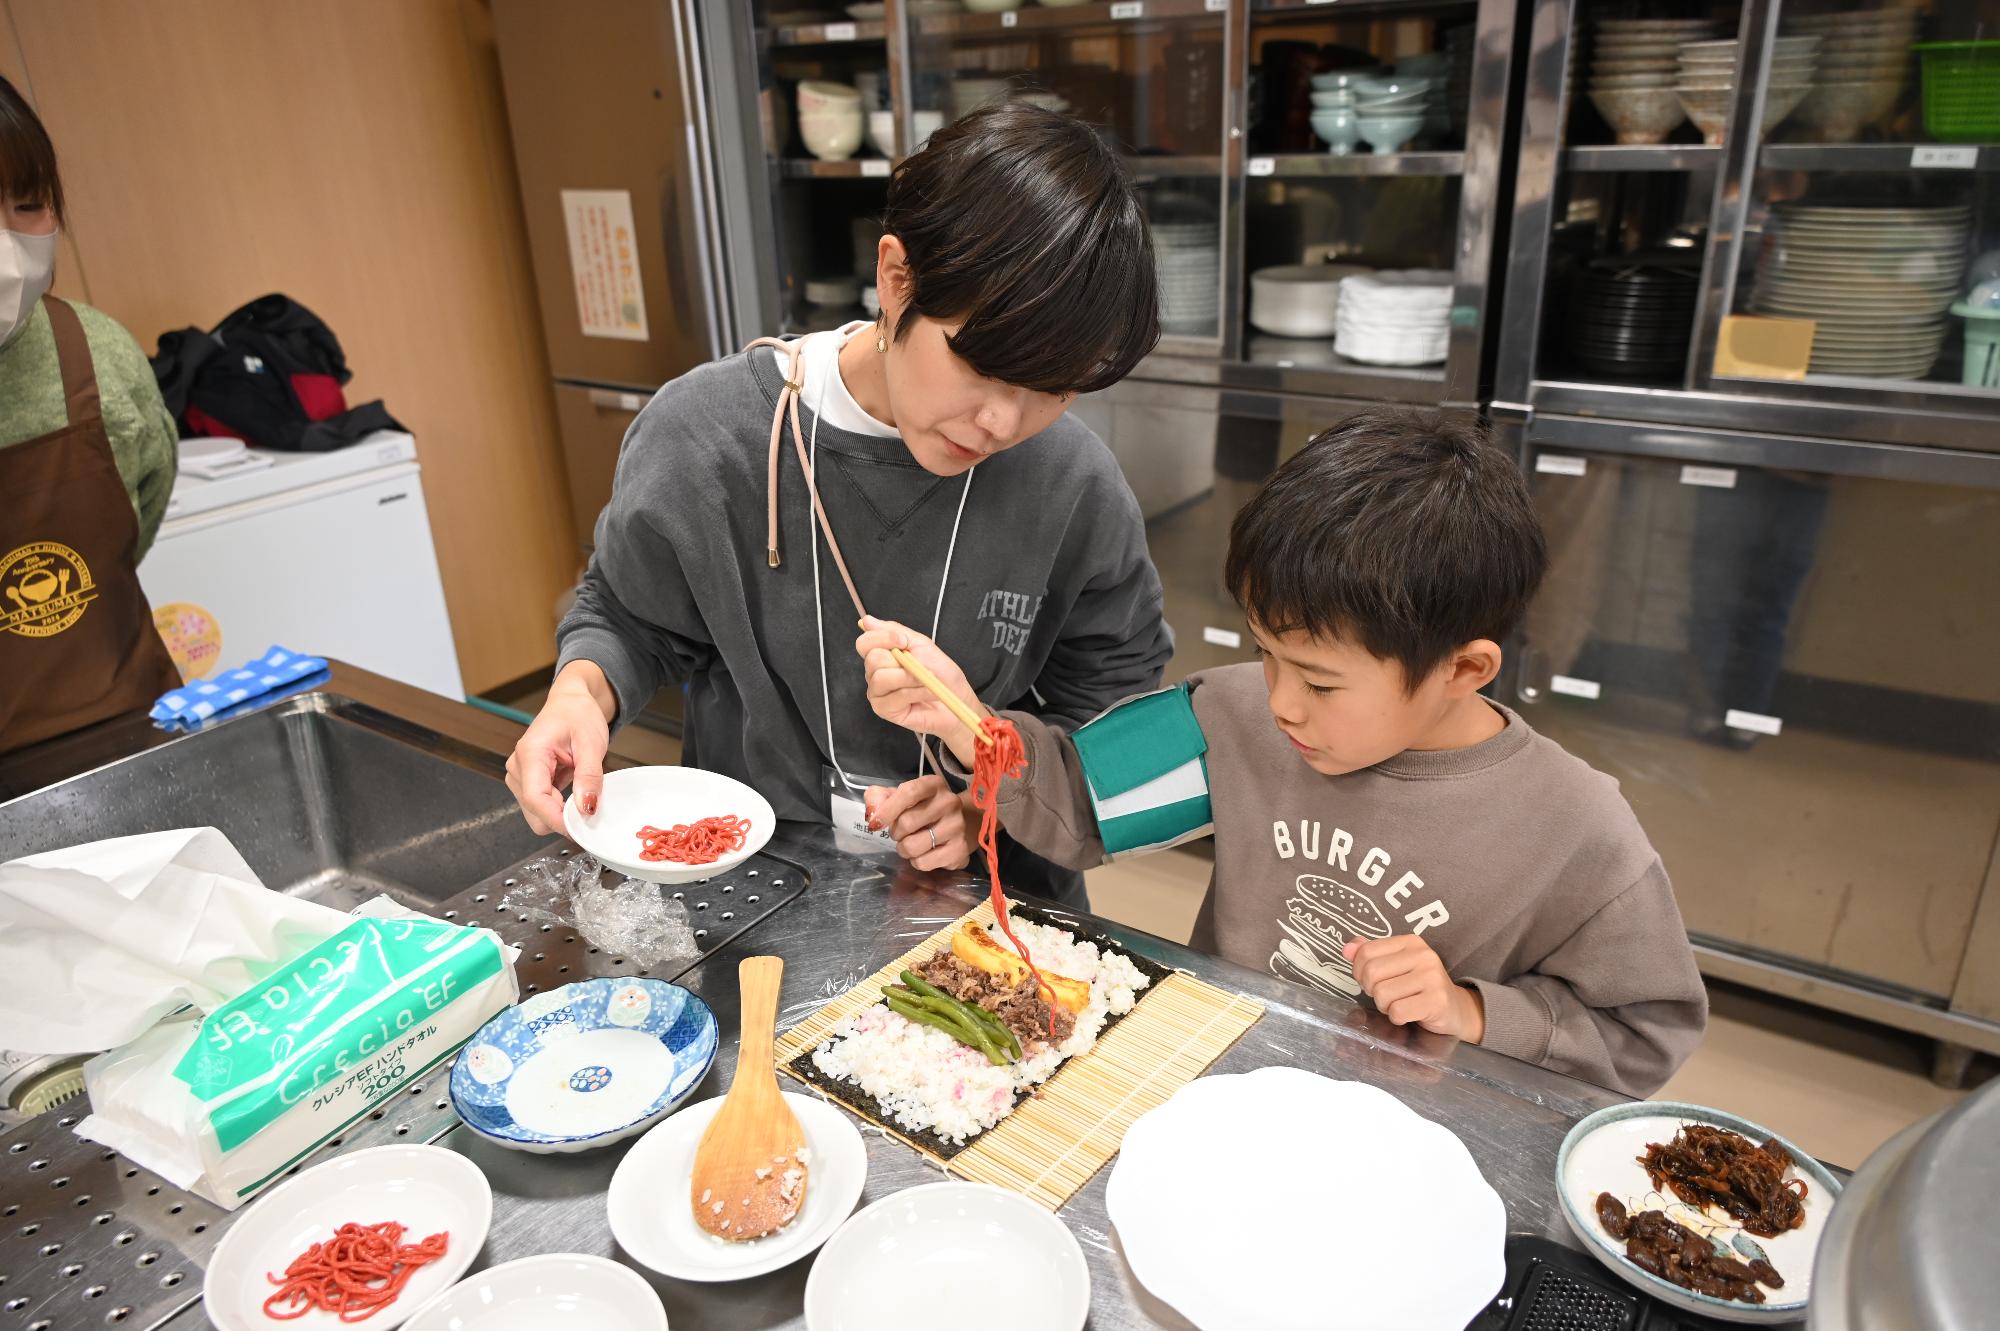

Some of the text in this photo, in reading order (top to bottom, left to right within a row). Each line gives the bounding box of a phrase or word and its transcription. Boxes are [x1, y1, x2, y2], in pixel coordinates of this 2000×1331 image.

[10, 594, 81, 624] MATSUMAE
[1273, 819, 1450, 936] BURGER
[280, 1012, 415, 1105] Crecia
[413, 971, 457, 1009] EF
[361, 1064, 407, 1101] 200
